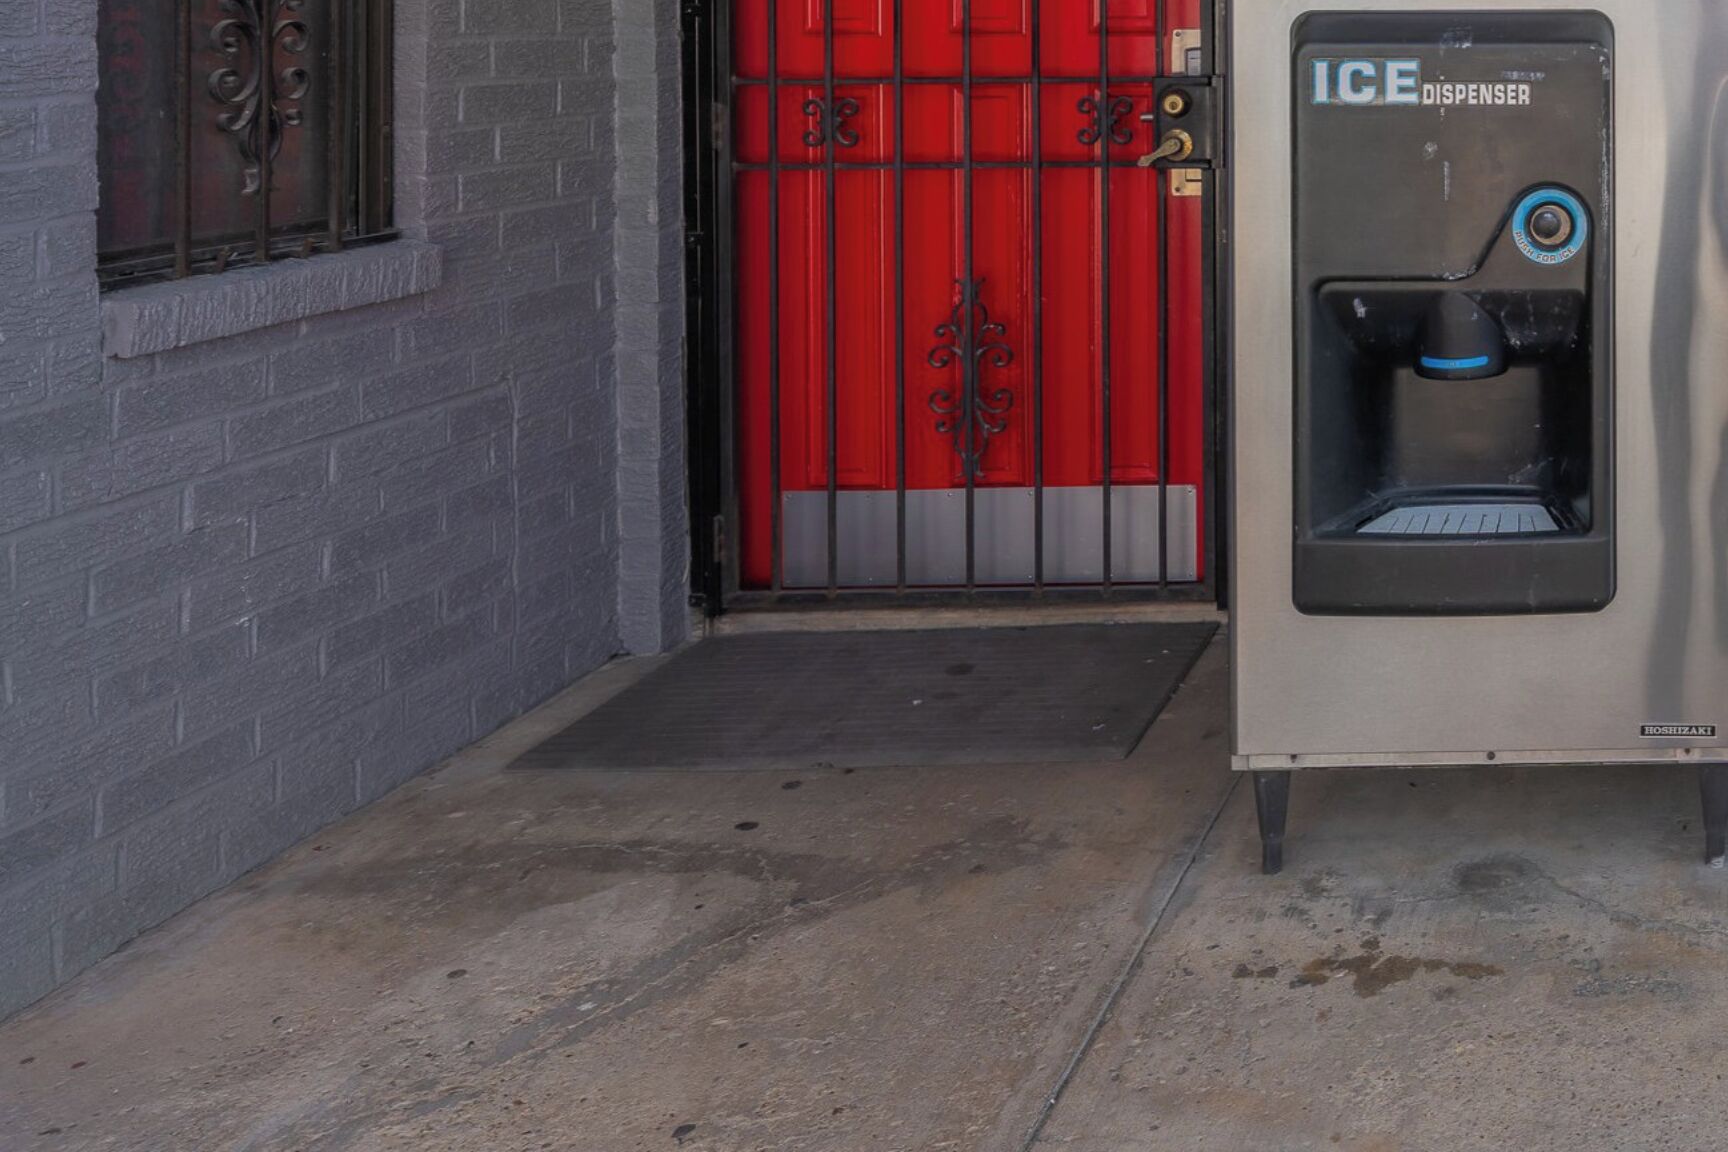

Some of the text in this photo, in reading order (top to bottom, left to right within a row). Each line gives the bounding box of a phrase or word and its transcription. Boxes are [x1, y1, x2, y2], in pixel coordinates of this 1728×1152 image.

[1312, 58, 1531, 105] ICE DISPENSER
[1515, 230, 1576, 263] PUSH FOR ICE
[1644, 726, 1712, 735] HOSHIZAKI
